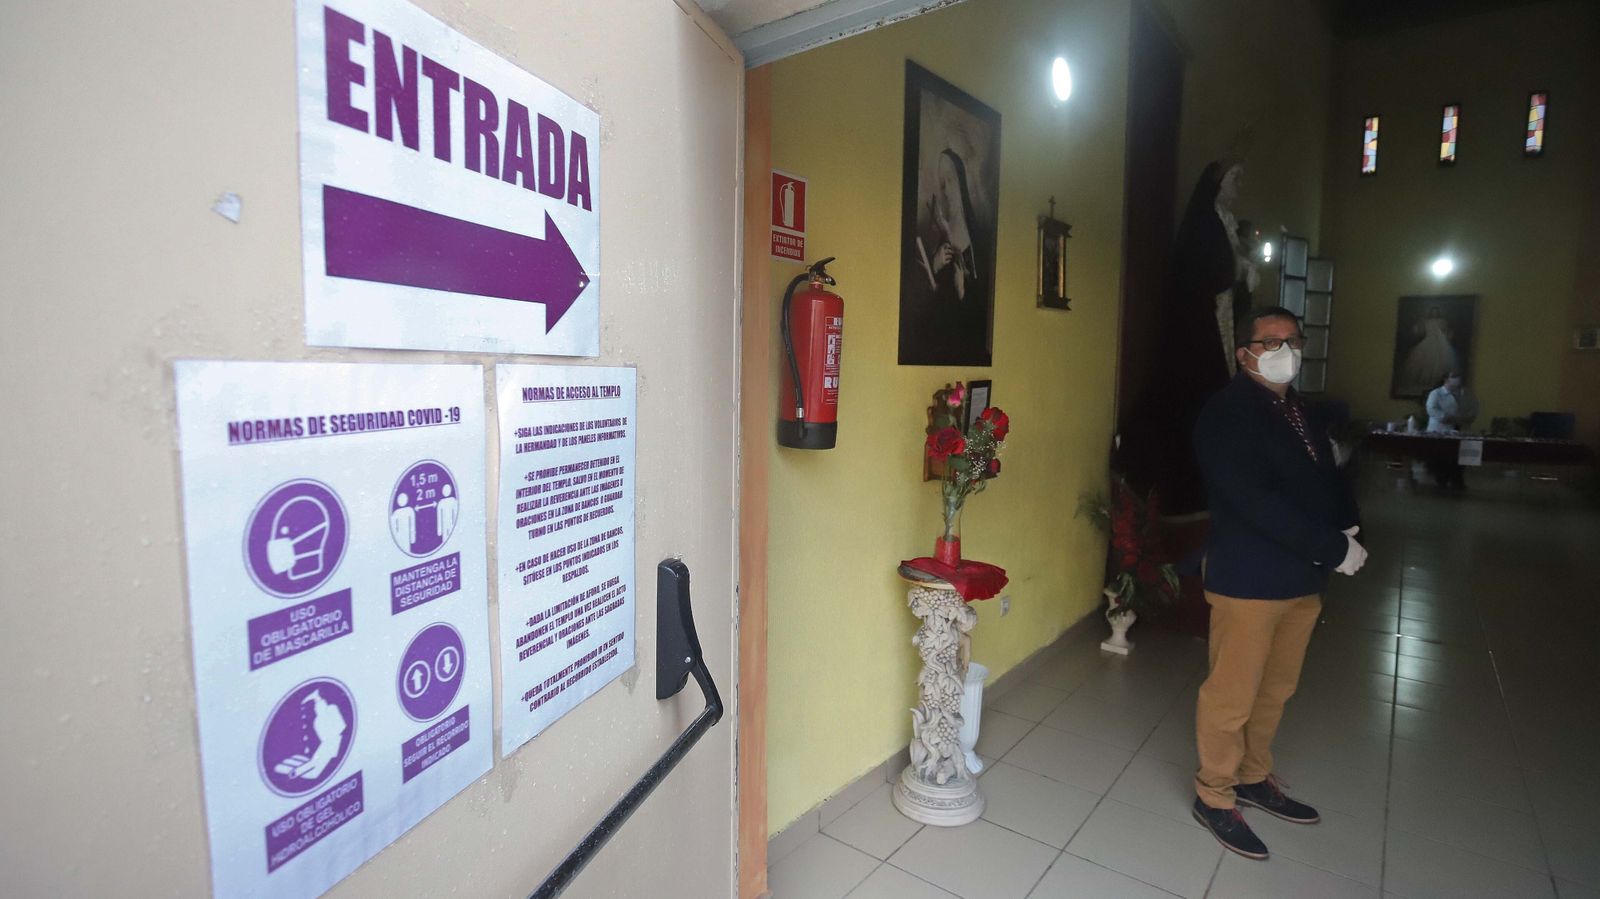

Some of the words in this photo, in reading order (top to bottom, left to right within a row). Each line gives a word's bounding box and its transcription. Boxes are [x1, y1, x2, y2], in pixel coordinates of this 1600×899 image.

[323, 4, 592, 212] ENTRADA
[773, 234, 796, 246] EXTINTOR
[797, 239, 804, 248] DE
[775, 246, 801, 257] INCENDIOS
[522, 387, 554, 401] NORMAS
[556, 387, 564, 400] DE
[566, 386, 591, 399] ACCESO
[592, 386, 598, 398] AL
[600, 385, 620, 398] TEMPLO
[228, 418, 304, 442] NORMAS
[308, 416, 326, 435] DE
[330, 410, 405, 433] SEGURIDAD
[408, 407, 442, 426] COVID
[445, 406, 461, 422] -19
[533, 426, 542, 436] LAS
[544, 422, 578, 434] INDICACIONES
[580, 421, 585, 431] DE
[594, 418, 621, 429] VOLUNTARIOS
[622, 417, 627, 425] DE
[516, 443, 522, 454] LA
[524, 438, 557, 452] HERMANDAD
[558, 438, 561, 447] Y
[562, 438, 568, 447] DE
[569, 436, 577, 446] LOS
[578, 434, 596, 444] PANELES
[410, 473, 425, 488] 1,5
[428, 473, 438, 484] m
[516, 485, 541, 499] INTERIOR
[542, 482, 551, 493] DEL
[573, 475, 586, 485] SALVO
[588, 473, 593, 482] EN
[594, 472, 598, 480] EL
[599, 468, 618, 479] MOMENTO
[619, 466, 624, 474] DE
[536, 467, 558, 480] PROHIBE
[559, 461, 589, 475] PERMANECER
[590, 457, 609, 468] DETENIDO
[610, 456, 615, 464] EN
[616, 455, 620, 464] EL
[416, 490, 423, 501] 2
[425, 488, 436, 498] m
[516, 512, 547, 529] ORACIONES
[548, 509, 554, 519] EN
[555, 508, 561, 517] LA
[562, 504, 574, 515] ZONA
[575, 502, 580, 512] DE
[581, 497, 599, 510] BANCOS
[604, 490, 623, 503] GUARDAR
[517, 498, 542, 514] REALIZAR
[543, 497, 549, 507] LA
[550, 489, 579, 505] REVERENCIA
[580, 486, 590, 497] ANTE
[591, 484, 599, 494] LAS
[600, 479, 619, 492] IMÁGENES
[528, 527, 546, 540] TURNO
[547, 525, 553, 534] EN
[564, 515, 582, 528] PUNTOS
[583, 514, 588, 522] DE
[527, 555, 542, 569] CASO
[543, 553, 549, 564] DE
[550, 546, 566, 561] HACER
[567, 543, 576, 554] USO
[577, 541, 583, 550] DE
[584, 539, 589, 548] LA
[590, 534, 600, 546] ZONA
[601, 532, 606, 541] DE
[546, 567, 552, 577] EN
[553, 562, 562, 574] LOS
[563, 554, 581, 570] PUNTOS
[582, 544, 605, 561] INDICADOS
[606, 542, 611, 552] EN
[393, 561, 445, 586] MANTENGA
[446, 557, 458, 568] LA
[395, 573, 443, 597] DISTANCIA
[444, 568, 457, 580] DE
[400, 581, 452, 607] SEGURIDAD
[545, 609, 550, 619] LA
[552, 595, 579, 616] LIMITACIÓN
[580, 592, 585, 602] DE
[601, 582, 606, 591] SE
[607, 576, 619, 589] RUEGA
[261, 610, 342, 647] OBLIGATORIO
[290, 605, 316, 622] USO
[516, 624, 548, 649] ABANDONEN
[550, 621, 554, 631] EL
[556, 611, 573, 628] TEMPLO
[574, 606, 583, 618] UNA
[592, 592, 611, 608] REALICEN
[612, 590, 615, 598] EL
[616, 584, 626, 596] ACTO
[519, 635, 554, 662] REVERENCIAL
[555, 633, 557, 642] Y
[559, 619, 584, 640] ORACIONES
[585, 612, 596, 625] ANTE
[605, 597, 624, 614] SAGRADAS
[254, 651, 272, 665] DE
[275, 621, 350, 657] MASCARILLA
[544, 664, 573, 689] TOTALMENTE
[574, 649, 597, 670] PROHIBIDO
[598, 645, 602, 655] IR
[603, 642, 608, 651] EN
[609, 632, 624, 647] SENTIDO
[530, 686, 560, 712] CONTRARIO
[560, 682, 566, 693] AL
[566, 664, 591, 688] RECORRIDO
[404, 746, 427, 767] SEGUIR
[428, 742, 435, 752] EL
[436, 720, 468, 747] RECORRIDO
[416, 716, 456, 747] OBLIGATORIO
[421, 744, 451, 768] INDICADO
[272, 816, 295, 837] USO
[296, 778, 357, 822] OBLIGATORIO
[300, 817, 315, 834] DE
[316, 806, 335, 823] GEL
